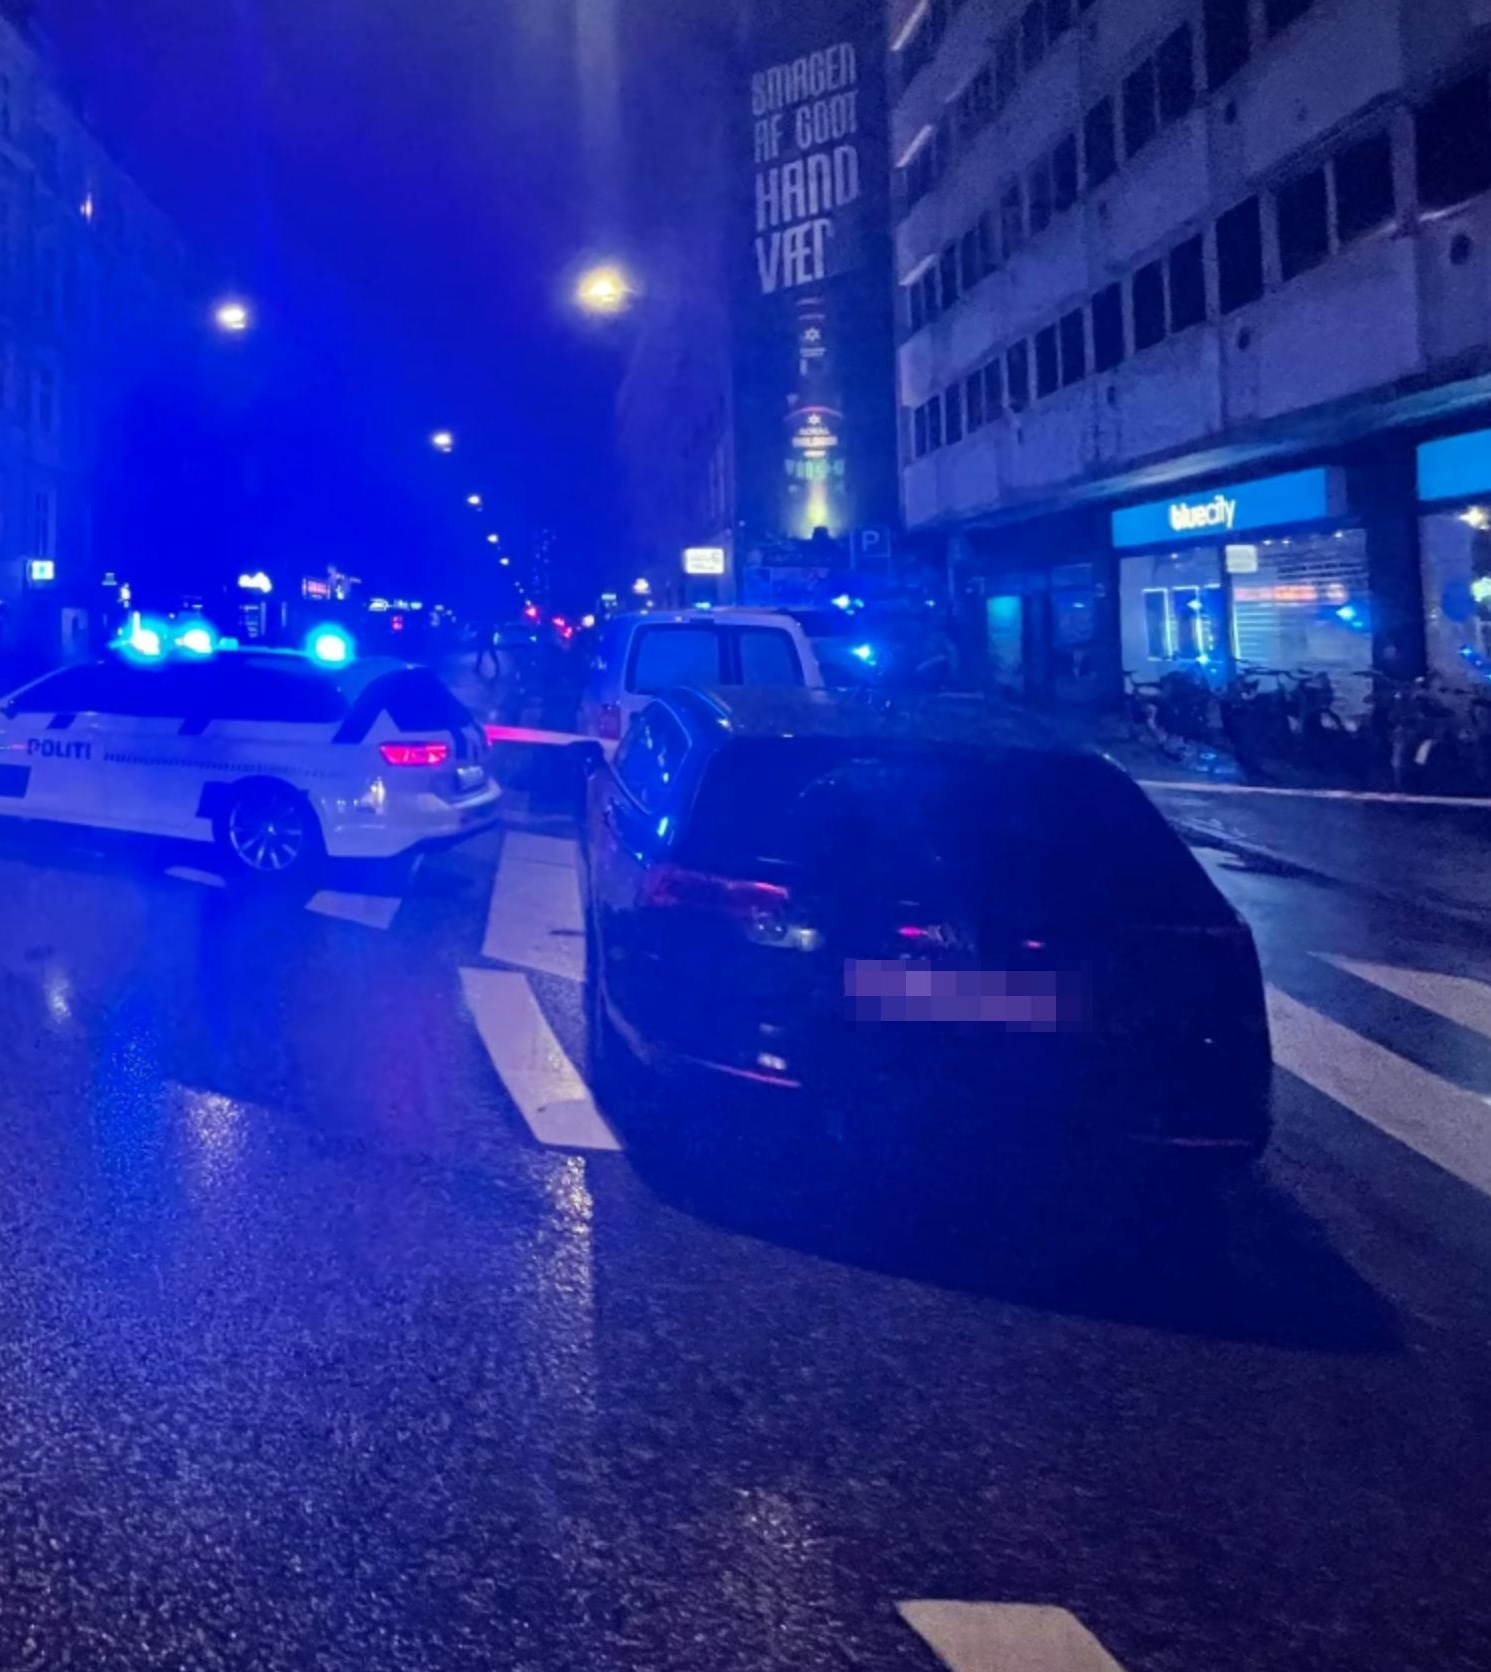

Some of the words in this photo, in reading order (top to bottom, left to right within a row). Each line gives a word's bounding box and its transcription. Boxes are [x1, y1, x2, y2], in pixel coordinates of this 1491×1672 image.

[751, 41, 857, 116] SMAGEN
[754, 113, 783, 163] AF
[754, 145, 860, 232] HAND
[754, 217, 835, 294] VÆR
[1170, 494, 1236, 531] bluecity
[862, 530, 880, 552] P
[27, 738, 92, 760] POLITI
